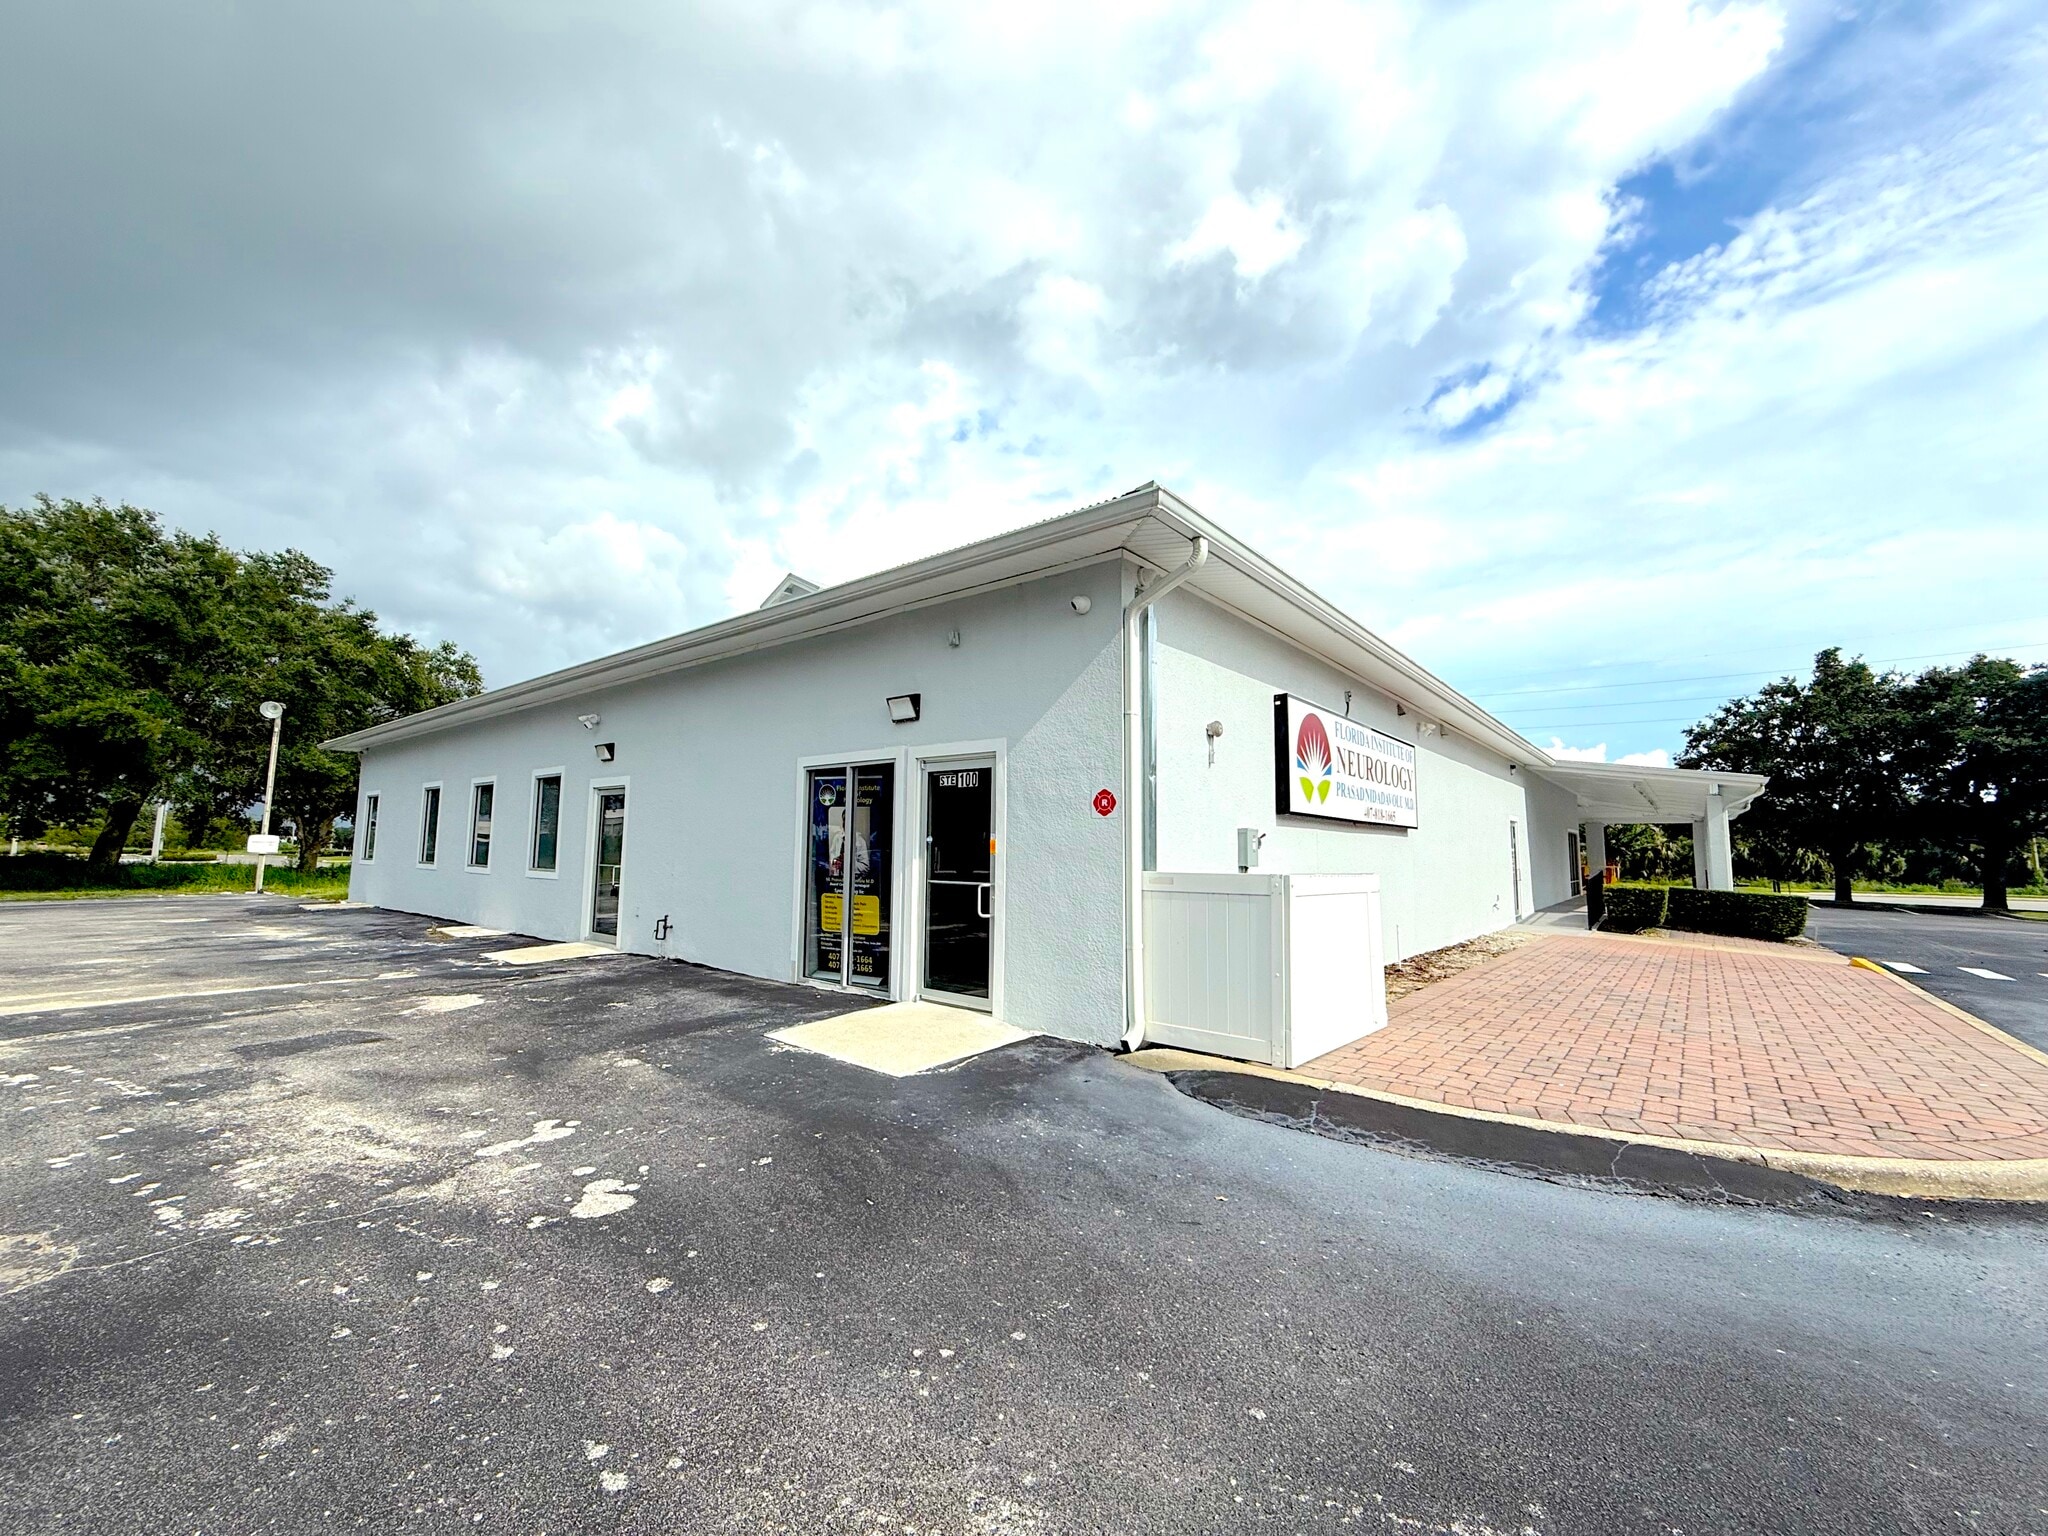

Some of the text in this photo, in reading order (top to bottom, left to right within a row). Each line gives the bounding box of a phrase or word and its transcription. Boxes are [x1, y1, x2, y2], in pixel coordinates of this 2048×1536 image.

[1335, 721, 1412, 763] FLORIDA INSTITUTE OF
[1336, 746, 1414, 791] NEUROLOGY
[940, 772, 978, 787] STE 100
[1336, 781, 1364, 801] PRASAD
[1101, 798, 1108, 806] R
